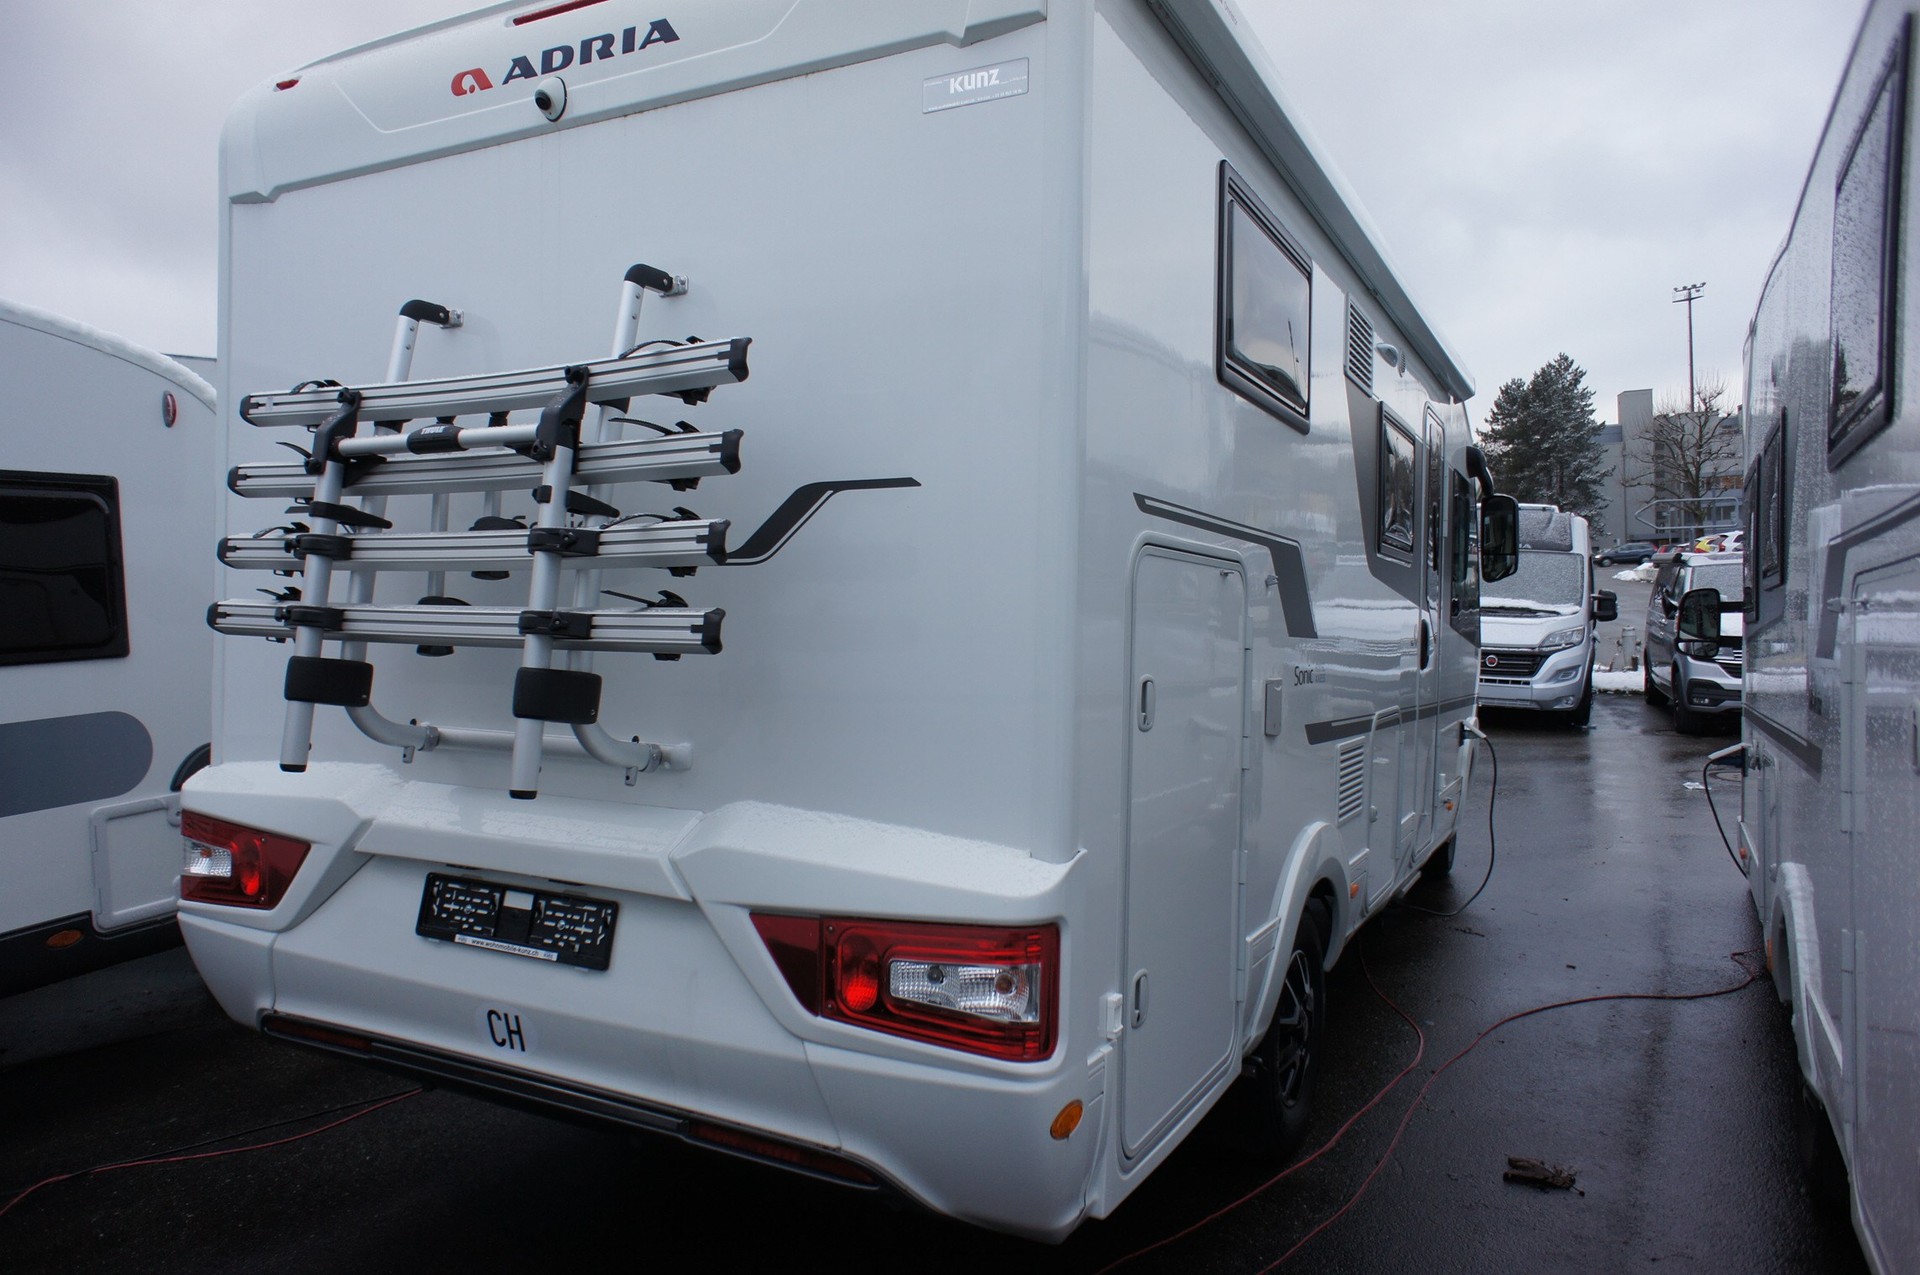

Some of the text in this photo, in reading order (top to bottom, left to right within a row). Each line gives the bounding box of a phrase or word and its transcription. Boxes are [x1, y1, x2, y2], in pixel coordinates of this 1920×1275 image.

[502, 18, 681, 86] ADRIA
[420, 425, 446, 435] THULE
[1294, 664, 1313, 686] Sonic
[486, 1009, 526, 1052] CH
